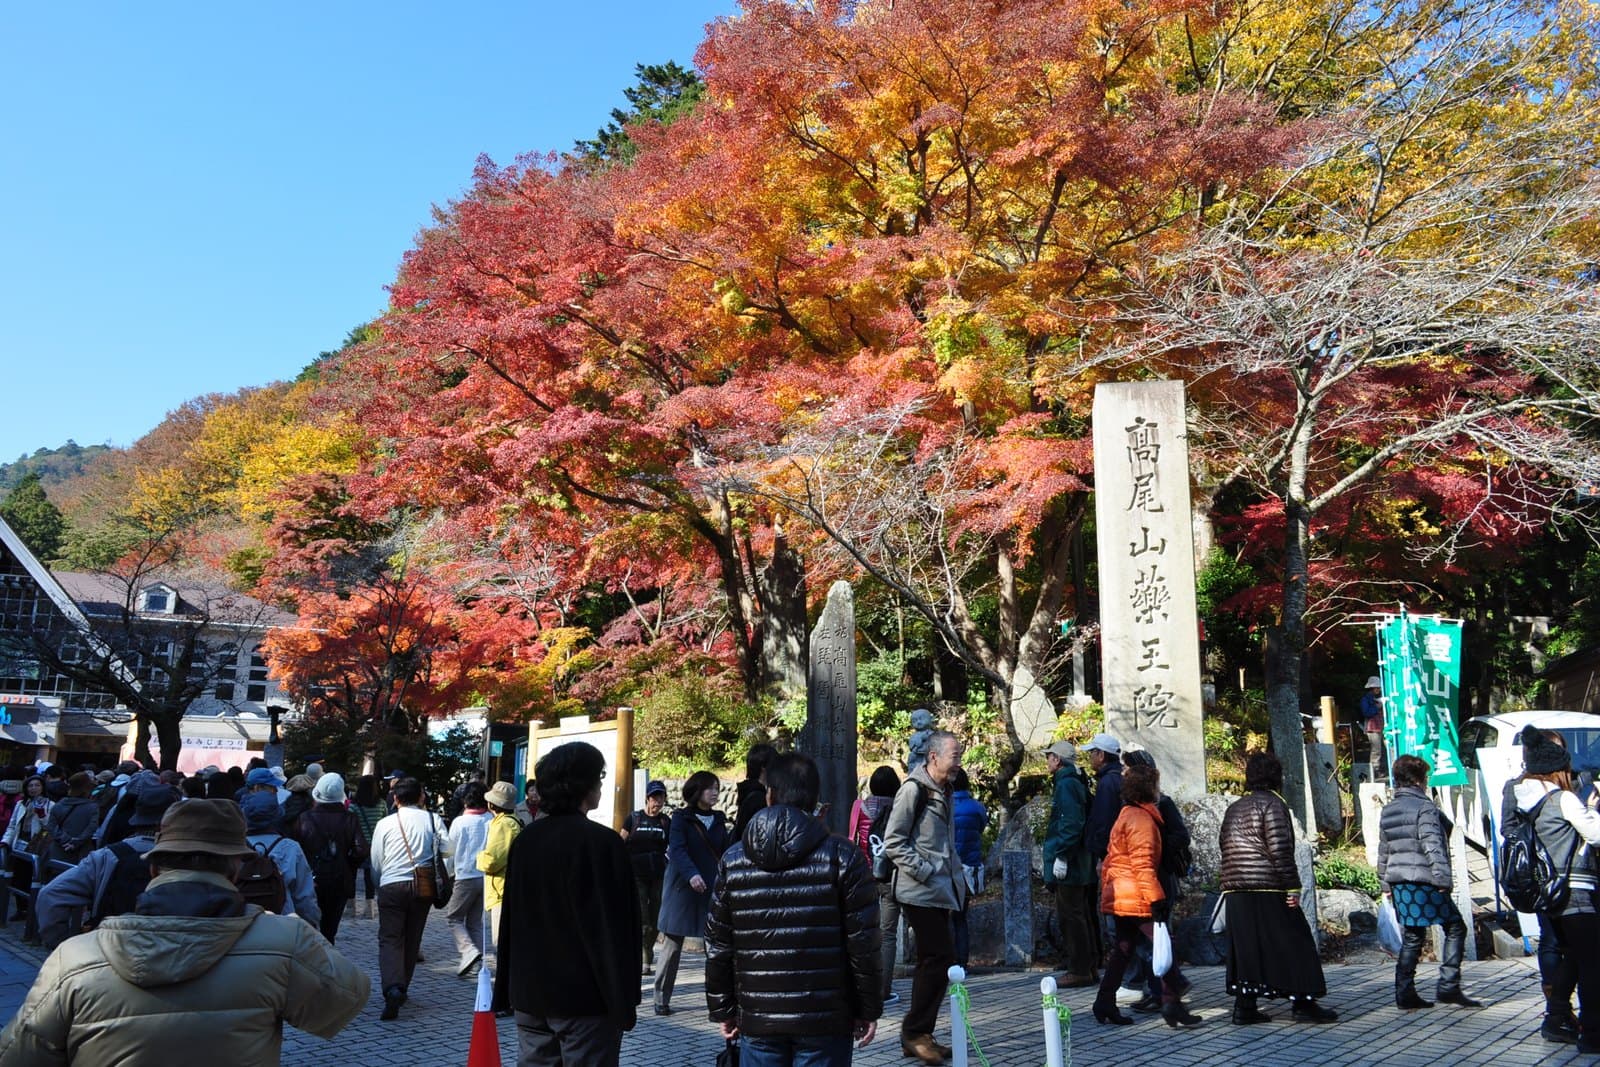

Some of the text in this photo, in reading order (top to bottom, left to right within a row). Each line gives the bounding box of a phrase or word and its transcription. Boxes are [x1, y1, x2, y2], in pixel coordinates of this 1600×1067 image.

[182, 738, 244, 746] もみじまつり
